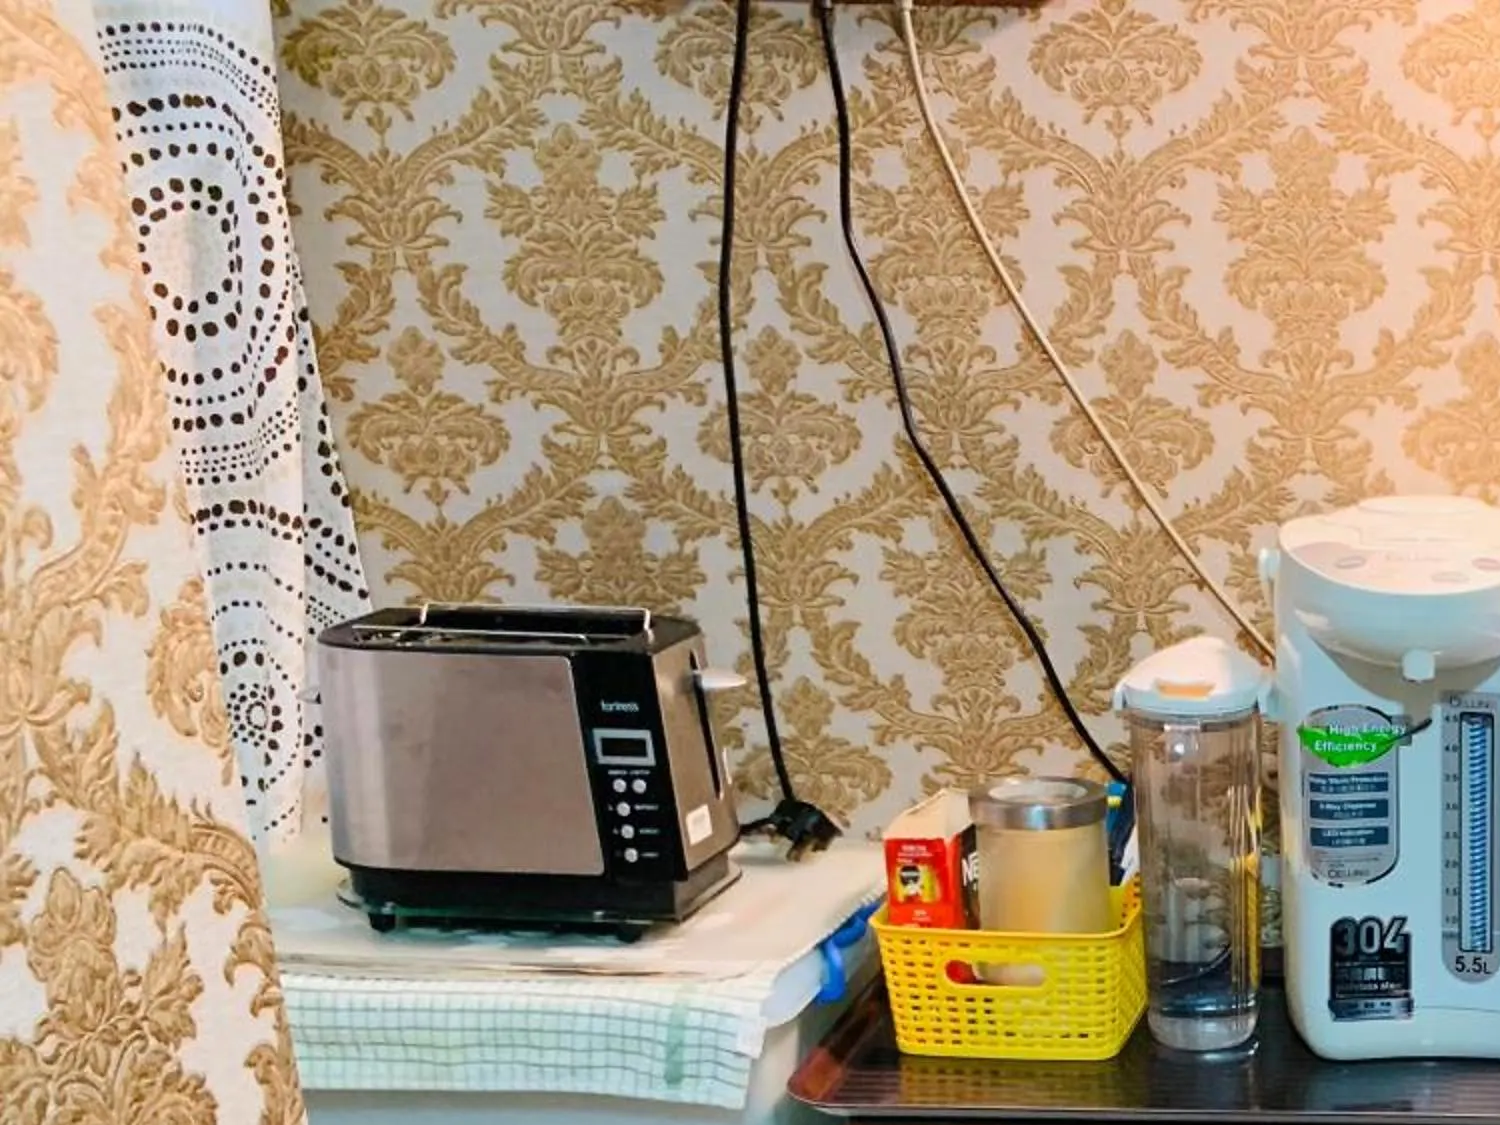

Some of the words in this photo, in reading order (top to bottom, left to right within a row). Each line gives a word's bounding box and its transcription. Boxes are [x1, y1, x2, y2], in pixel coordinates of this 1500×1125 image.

[1329, 723, 1361, 738] High
[1314, 739, 1377, 752] Efficiency
[1335, 918, 1408, 955] 304
[1455, 956, 1492, 974] 5.5L
